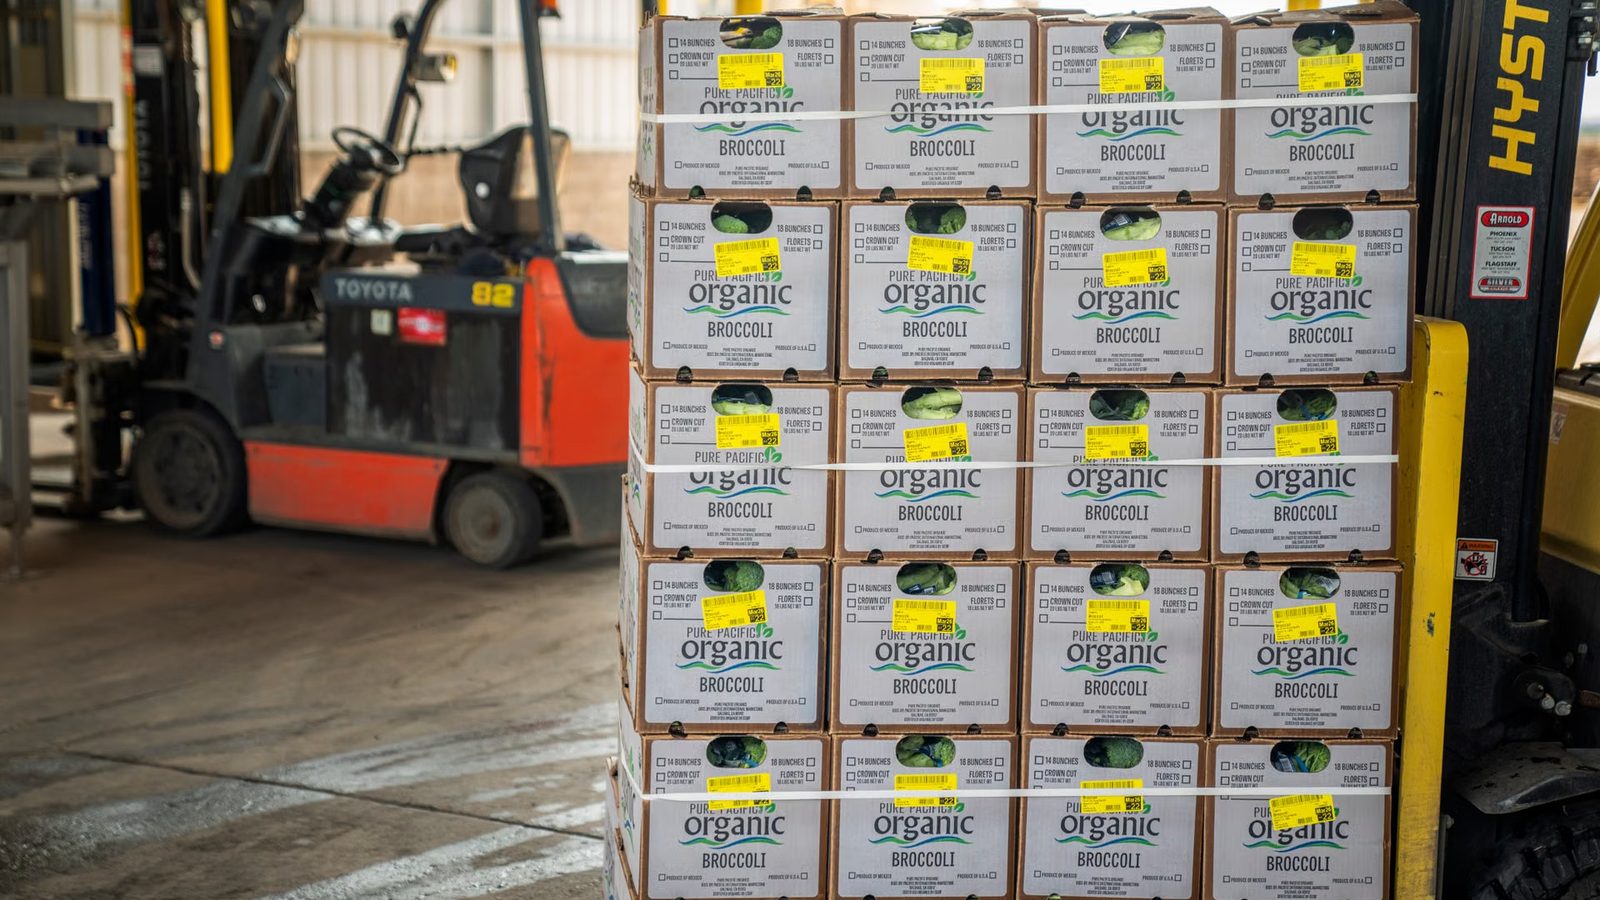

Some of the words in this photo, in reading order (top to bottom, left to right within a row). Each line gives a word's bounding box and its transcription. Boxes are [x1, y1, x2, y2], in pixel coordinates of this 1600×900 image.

[680, 39, 686, 47] 14
[687, 39, 715, 47] BUNCHES
[787, 39, 794, 47] 18
[795, 39, 823, 47] BUNCHES
[871, 41, 878, 49] 14
[878, 41, 906, 49] BUNCHES
[977, 40, 984, 48] 18
[985, 39, 1012, 48] BUNCHES
[1063, 59, 1084, 68] CROWN
[1085, 59, 1097, 67] CUT
[1179, 56, 1204, 66] FLORETS
[1252, 60, 1273, 69] CROWN
[1274, 60, 1286, 68] CUT
[1368, 55, 1393, 65] FLORETS
[704, 87, 731, 99] PURE
[736, 86, 777, 100] PACIFIC
[1087, 92, 1113, 105] PURE
[1118, 91, 1158, 105] PACIFIC
[890, 100, 994, 130] organic
[1271, 103, 1374, 135] organic
[719, 139, 785, 157] BROCCOLI
[909, 139, 975, 158] BROCCOLI
[1100, 143, 1165, 162] BROCCOLI
[1289, 142, 1354, 162] BROCCOLI
[1490, 213, 1522, 224] ARNOLD
[678, 223, 706, 231] BUNCHES
[777, 224, 784, 232] 18
[866, 224, 872, 232] 14
[873, 224, 900, 232] BUNCHES
[971, 224, 977, 232] 18
[978, 224, 1005, 232] BUNCHES
[1060, 243, 1081, 252] CROWN
[1175, 242, 1199, 251] FLORETS
[1253, 244, 1273, 253] CROWN
[1367, 241, 1391, 251] FLORETS
[889, 270, 915, 282] PURE
[920, 270, 960, 283] PACIFIC
[1276, 277, 1301, 290] PURE
[1307, 276, 1346, 289] PACIFIC
[335, 278, 413, 301] TOYOTA
[472, 281, 515, 307] 82
[689, 283, 792, 310] organic
[884, 282, 986, 311] organic
[1078, 288, 1180, 317] organic
[1271, 288, 1372, 318] organic
[707, 321, 772, 338] BROCCOLI
[902, 320, 967, 338] BROCCOLI
[1096, 326, 1160, 344] BROCCOLI
[1289, 326, 1353, 345] BROCCOLI
[863, 410, 869, 418] 14
[870, 410, 897, 418] BUNCHES
[966, 410, 973, 418] 18
[974, 410, 1000, 418] BUNCHES
[1051, 410, 1057, 418] 14
[1058, 410, 1084, 418] BUNCHES
[1154, 410, 1160, 418] 18
[1161, 410, 1188, 418] BUNCHES
[672, 418, 692, 426] CROWN
[786, 419, 811, 428] FLORETS
[1238, 424, 1258, 433] CROWN
[1259, 424, 1270, 432] CUT
[1351, 421, 1375, 430] FLORETS
[695, 451, 720, 463] PURE
[726, 451, 765, 464] PACIFIC
[880, 467, 982, 495] organic
[1068, 467, 1168, 495] organic
[1256, 466, 1356, 496] organic
[707, 502, 772, 518] BROCCOLI
[898, 504, 962, 522] BROCCOLI
[1085, 504, 1148, 521] BROCCOLI
[1273, 504, 1337, 522] BROCCOLI
[768, 582, 775, 590] 18
[776, 582, 802, 590] BUNCHES
[865, 584, 892, 592] BUNCHES
[961, 584, 968, 592] 18
[968, 584, 995, 592] BUNCHES
[1163, 599, 1187, 607] FLORETS
[1353, 602, 1377, 610] FLORETS
[687, 627, 712, 639] PURE
[718, 627, 757, 639] PACIFIC
[681, 639, 783, 666] organic
[875, 641, 976, 668] organic
[1067, 643, 1168, 670] organic
[1257, 646, 1358, 672] organic
[699, 676, 763, 693] BROCCOLI
[893, 678, 956, 695] BROCCOLI
[1084, 680, 1148, 696] BROCCOLI
[1274, 682, 1338, 699] BROCCOLI
[857, 758, 864, 766] 14
[864, 758, 891, 766] BUNCHES
[960, 758, 966, 766] 18
[967, 758, 993, 766] BUNCHES
[684, 815, 785, 843] organic
[874, 814, 974, 842] organic
[1060, 815, 1161, 842] organic
[702, 852, 766, 869] BROCCOLI
[891, 851, 955, 868] BROCCOLI
[1077, 851, 1140, 868] BROCCOLI
[1266, 855, 1330, 872] BROCCOLI
